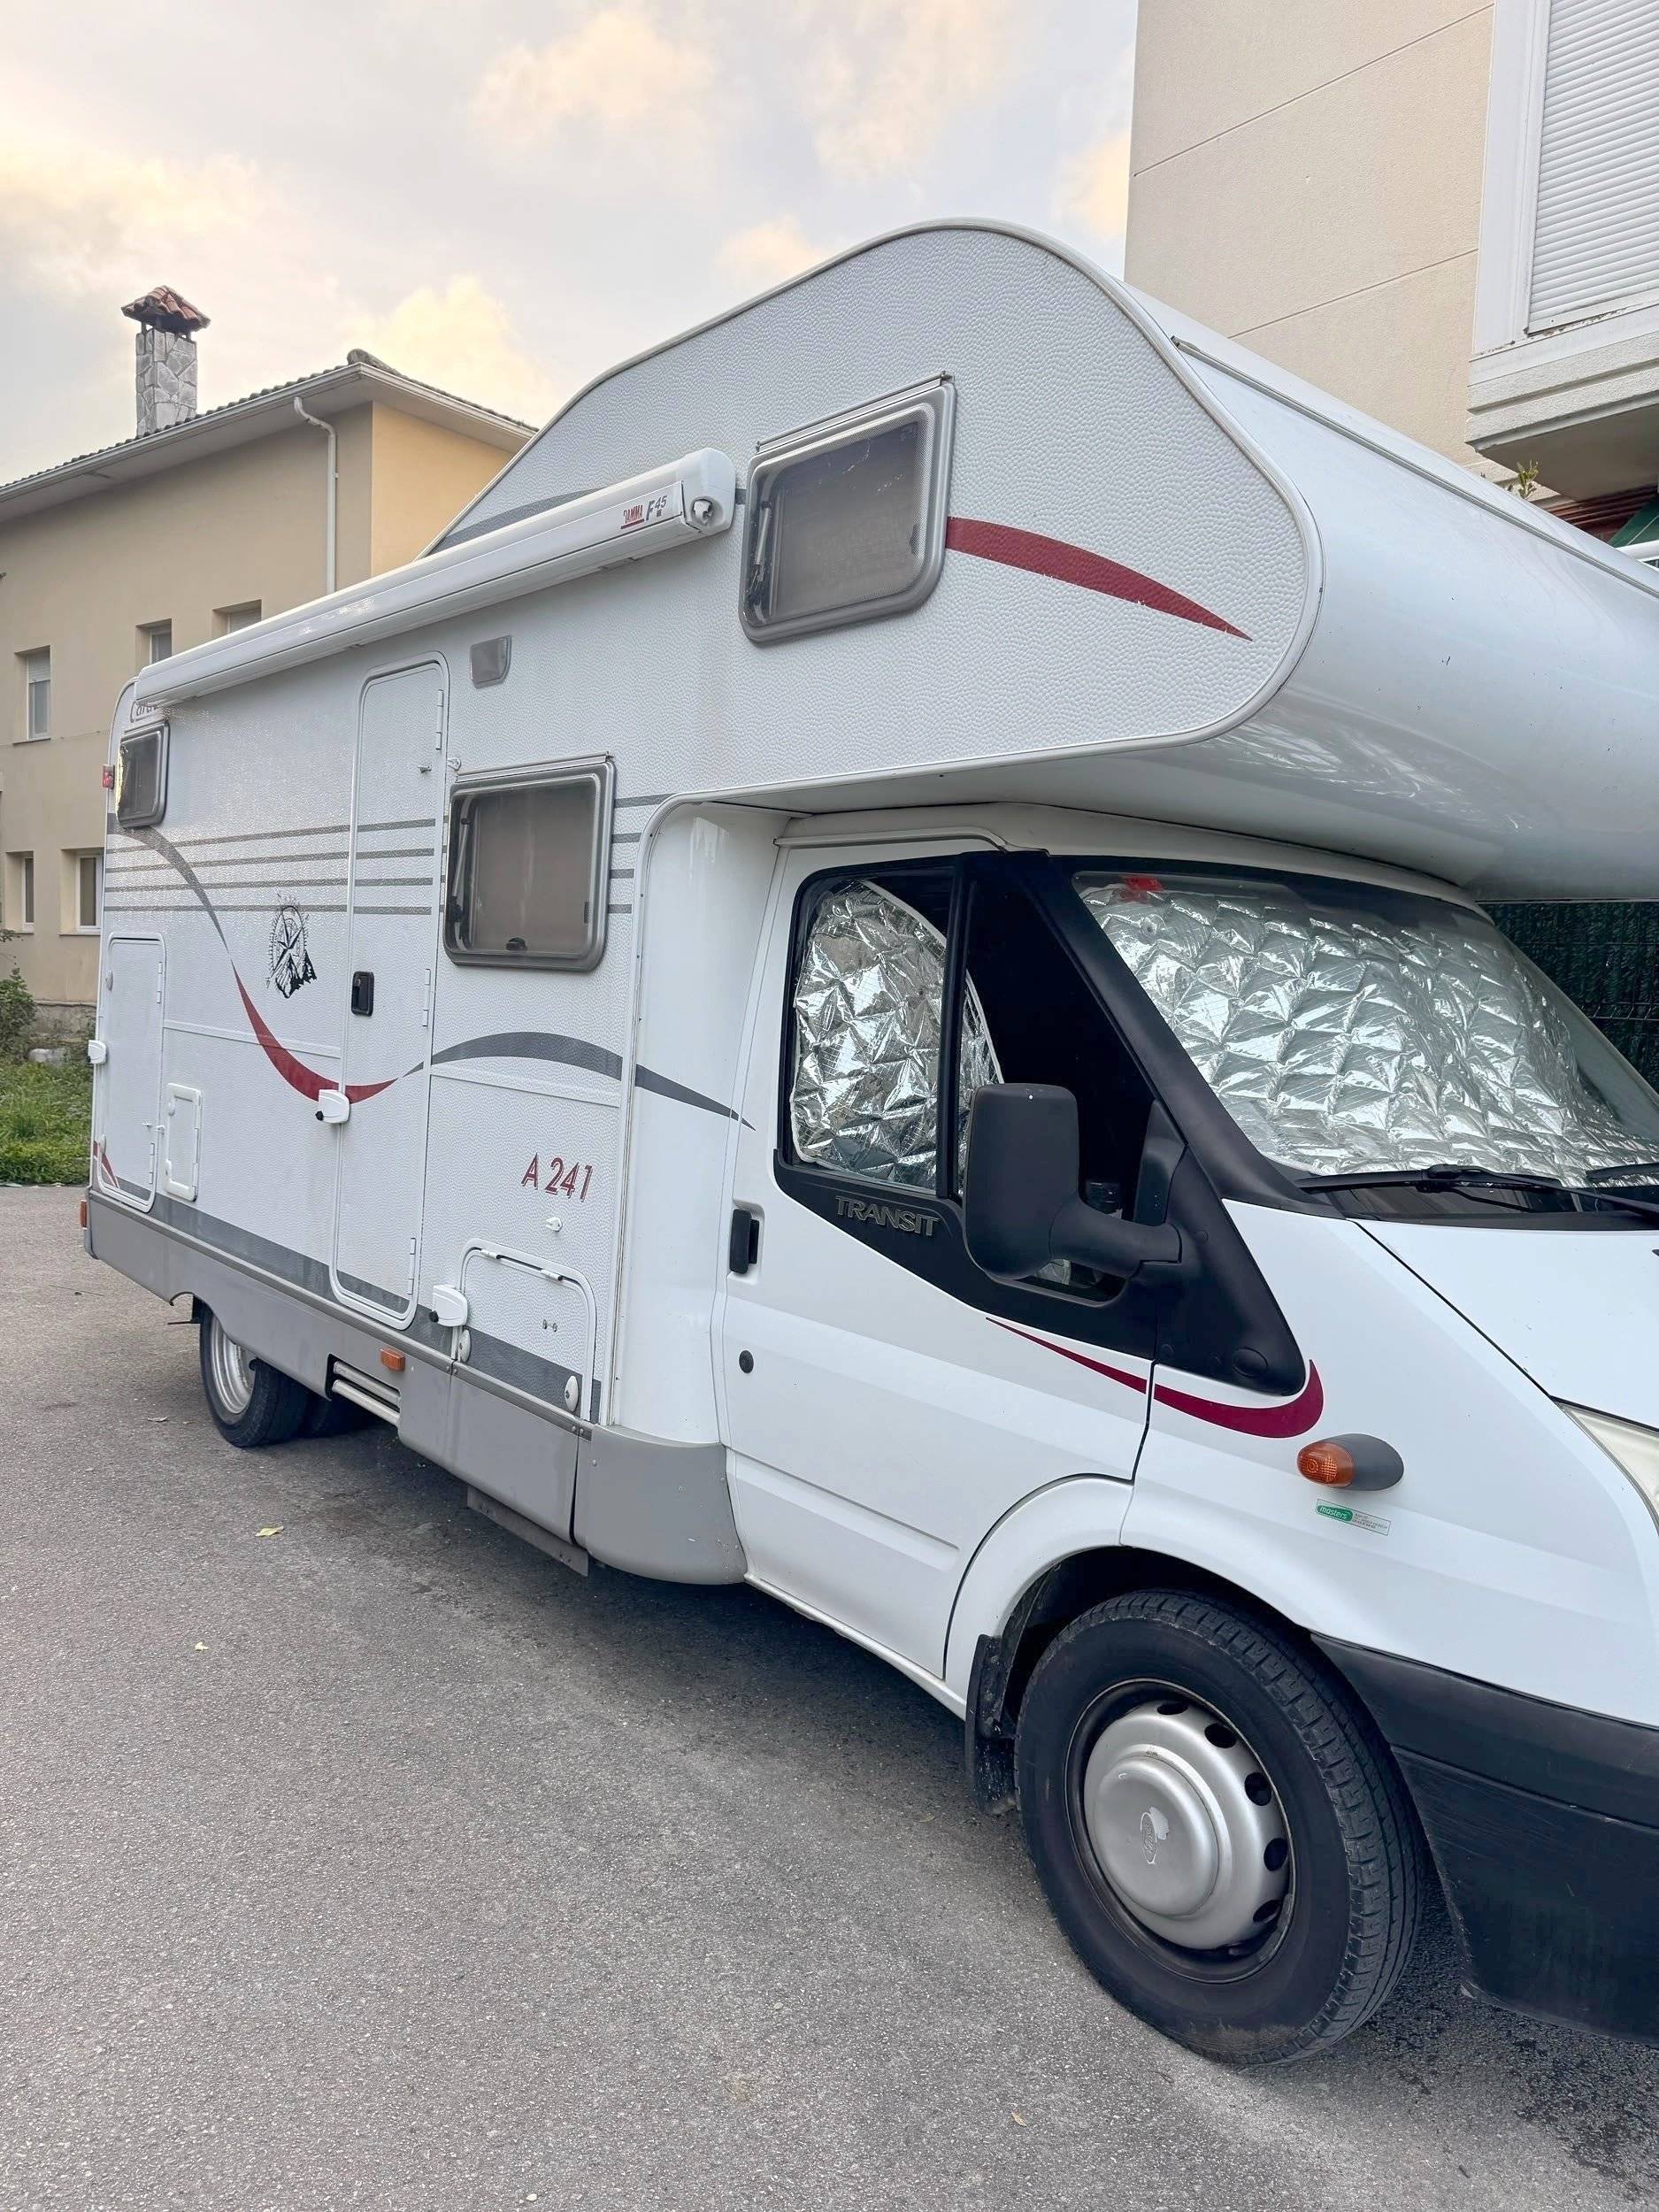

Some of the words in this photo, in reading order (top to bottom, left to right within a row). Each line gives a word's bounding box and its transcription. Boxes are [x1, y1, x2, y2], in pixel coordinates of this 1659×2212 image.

[520, 1151, 539, 1191] A
[544, 1156, 593, 1203] 241
[835, 1194, 940, 1237] TRANSIT
[1319, 1506, 1348, 1520] masters
